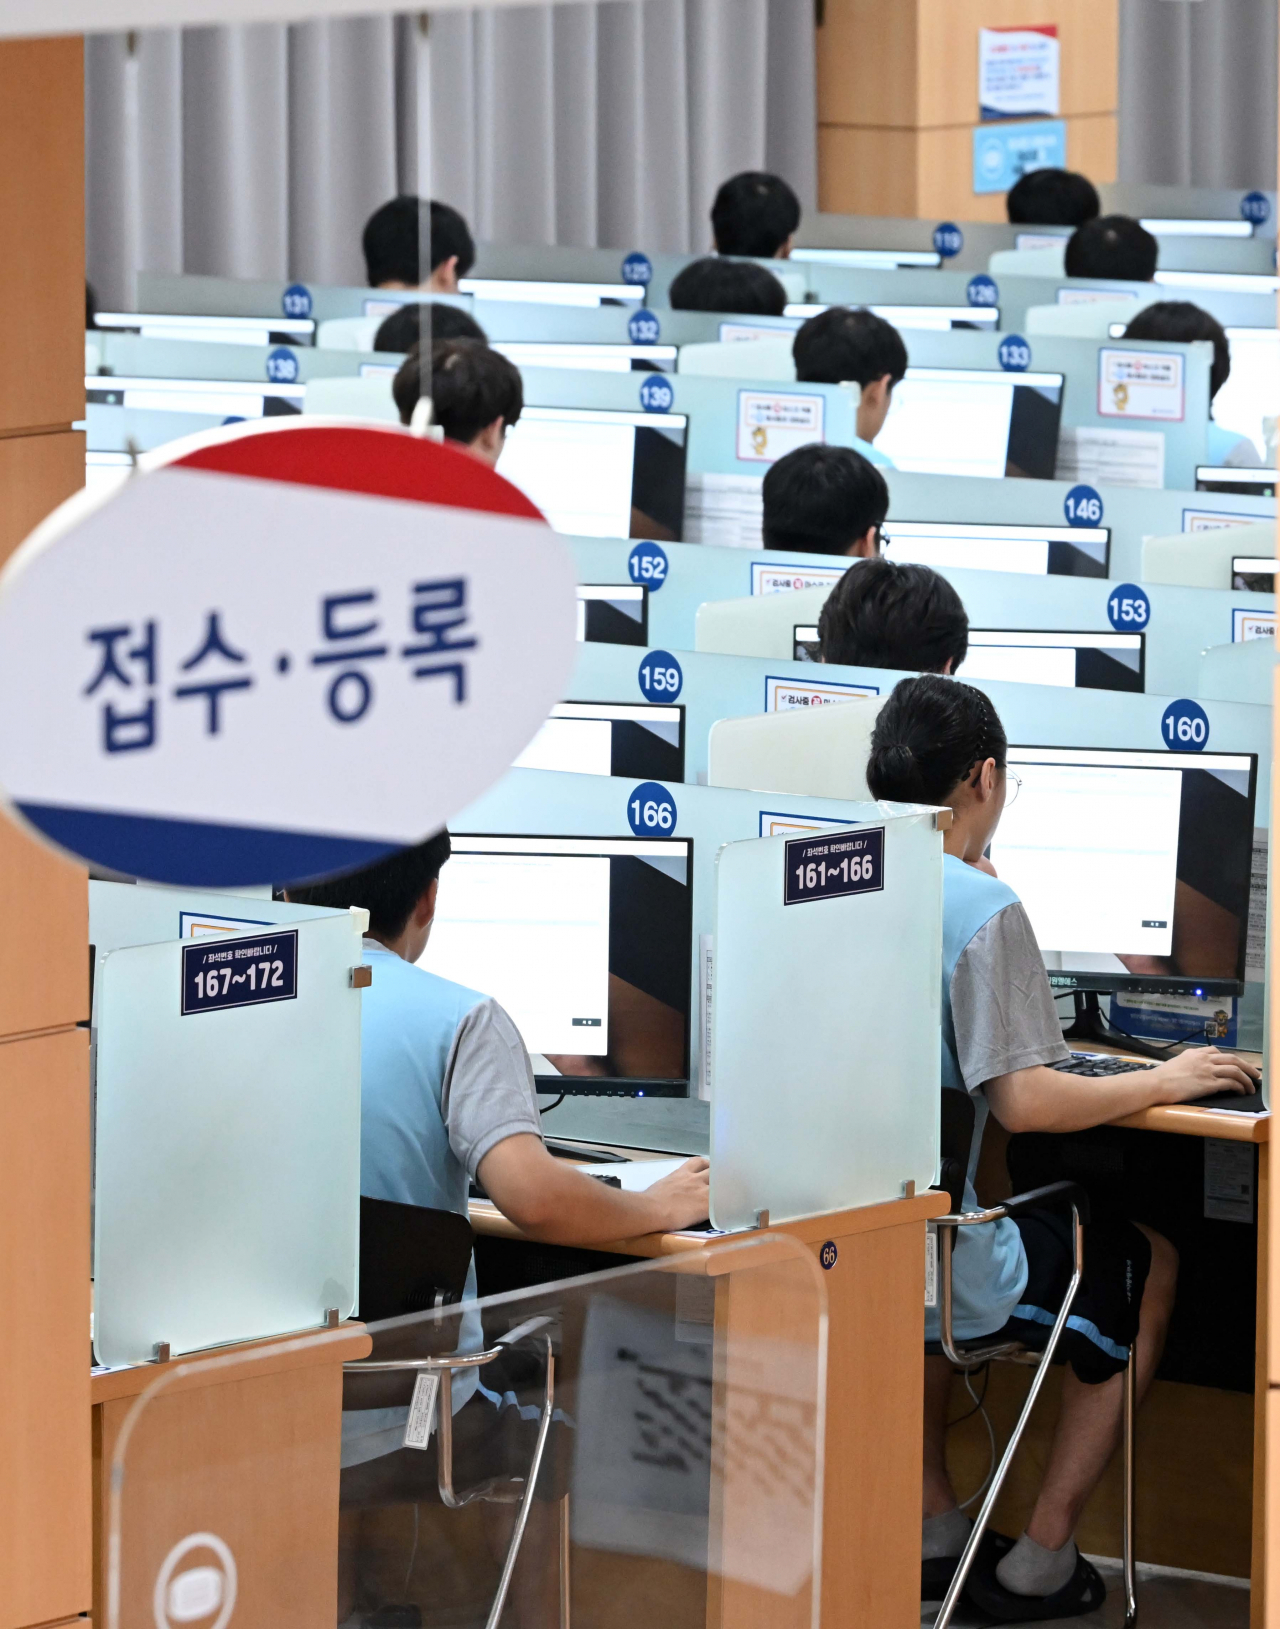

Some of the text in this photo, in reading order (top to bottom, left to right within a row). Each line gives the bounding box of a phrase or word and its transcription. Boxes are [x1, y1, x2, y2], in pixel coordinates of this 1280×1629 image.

[936, 231, 961, 249] 119
[284, 294, 311, 315] 131
[631, 320, 658, 341] 132
[1001, 345, 1029, 366] 133
[268, 358, 297, 380] 138
[642, 385, 671, 408] 139
[1066, 497, 1100, 521] 146
[630, 555, 665, 579] 152
[1109, 597, 1147, 623] 153
[83, 576, 478, 754] 접수·등록
[642, 665, 679, 692] 159
[1165, 715, 1206, 743] 160
[631, 799, 673, 829] 166
[806, 845, 829, 857] 좌석번호
[830, 840, 863, 853] 확인바랍니다
[795, 854, 873, 890] 161~166
[208, 950, 233, 963] 좌석번호
[234, 945, 272, 959] 확인바랍니다
[194, 960, 284, 999] 167~172
[823, 1246, 835, 1265] 66
